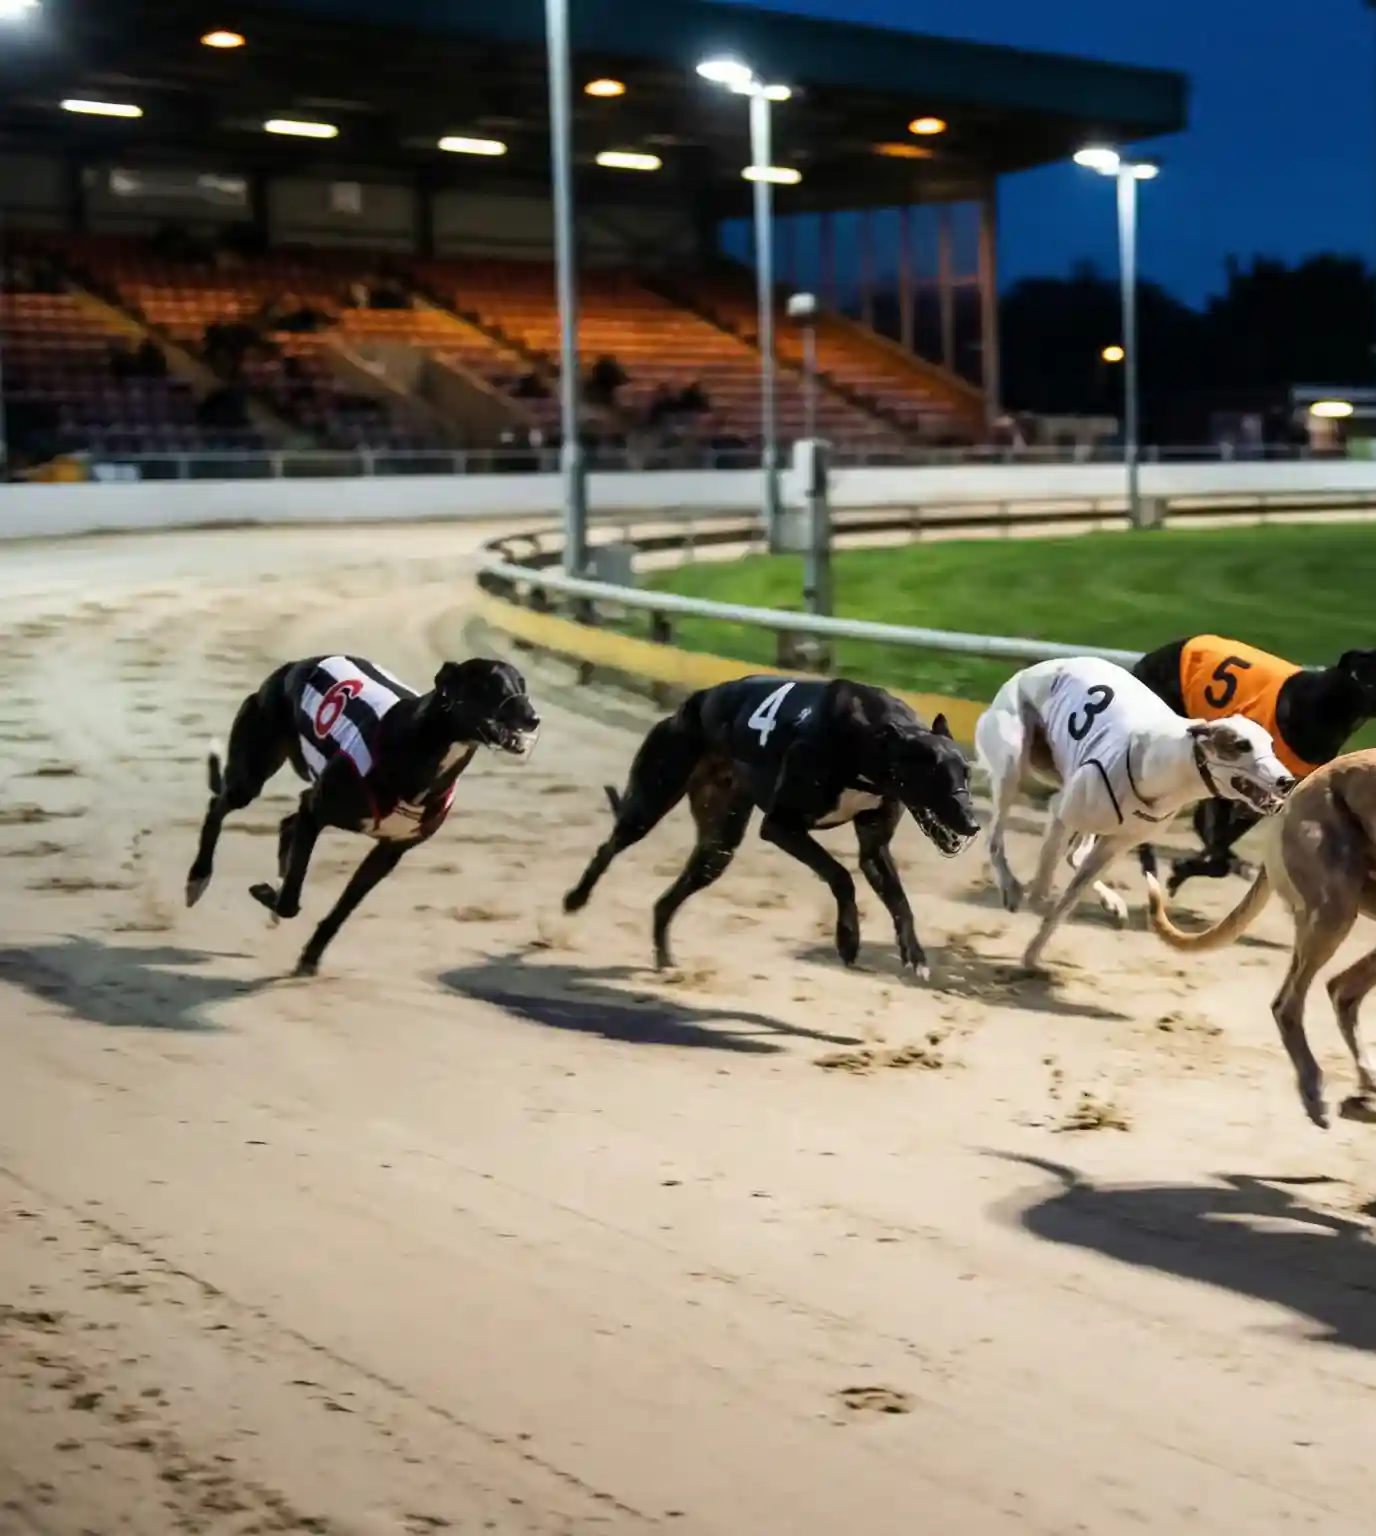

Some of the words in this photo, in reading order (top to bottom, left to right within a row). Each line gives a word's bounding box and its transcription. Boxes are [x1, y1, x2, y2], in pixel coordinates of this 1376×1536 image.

[313, 679, 363, 739] 6
[1204, 656, 1242, 708] 5
[748, 682, 796, 747] 4
[1068, 685, 1115, 740] 3
